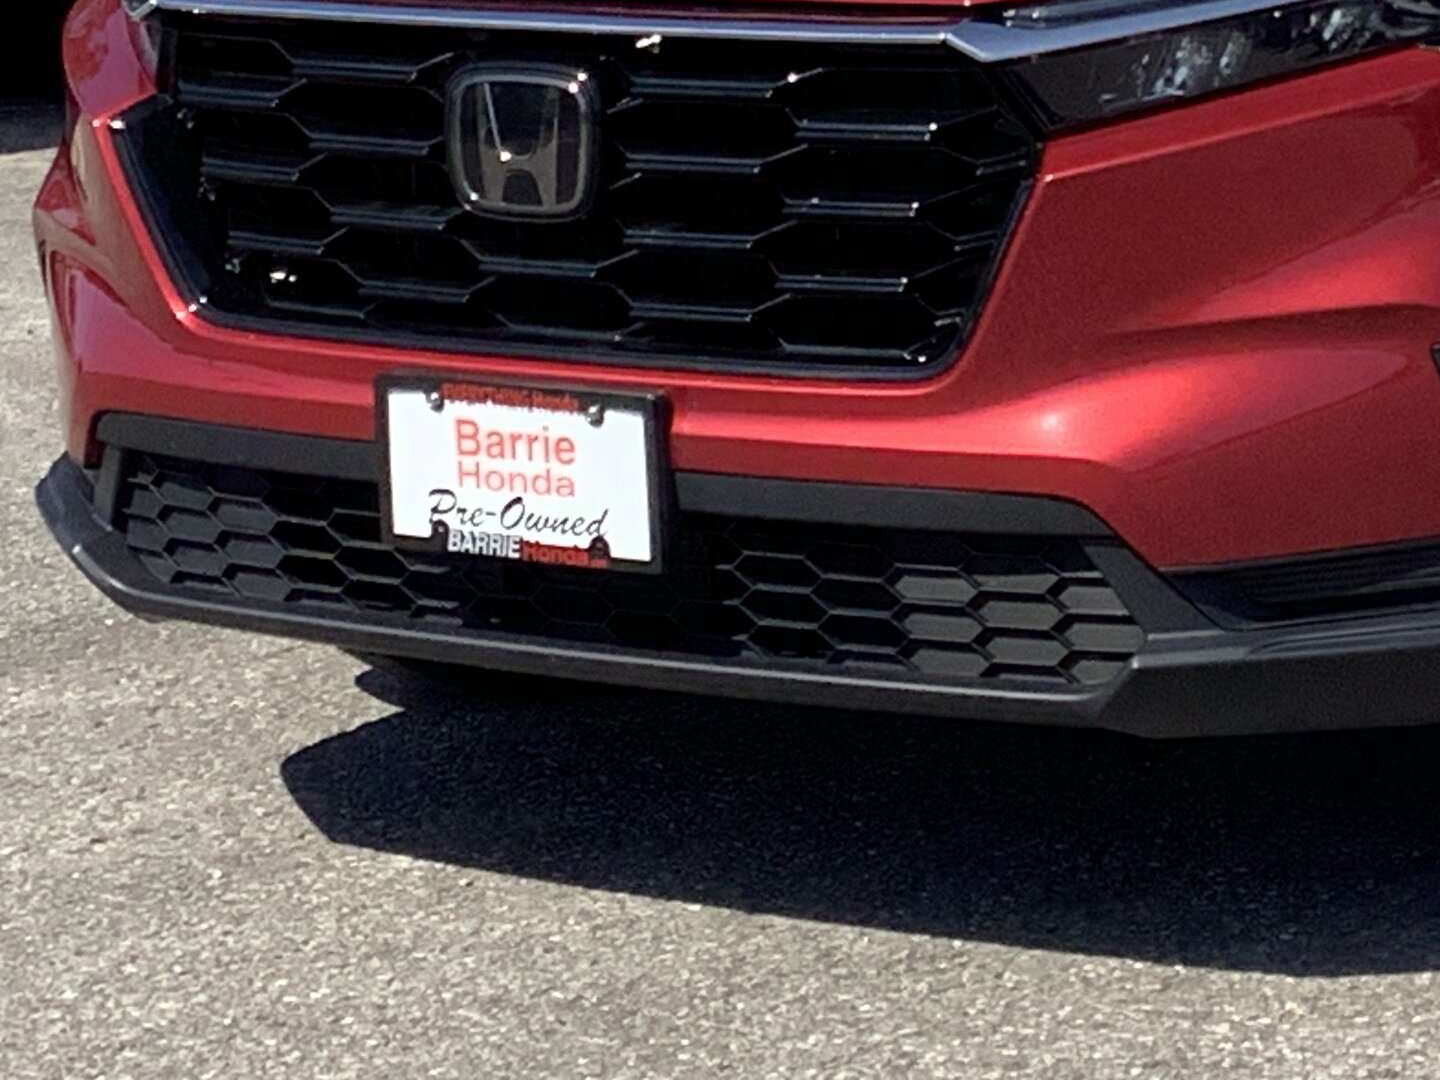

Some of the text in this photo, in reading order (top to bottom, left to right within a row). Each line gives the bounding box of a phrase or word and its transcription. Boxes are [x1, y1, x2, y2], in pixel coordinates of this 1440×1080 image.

[454, 418, 576, 466] Barrie
[456, 460, 576, 498] Honda
[428, 487, 609, 538] Pre-Owned
